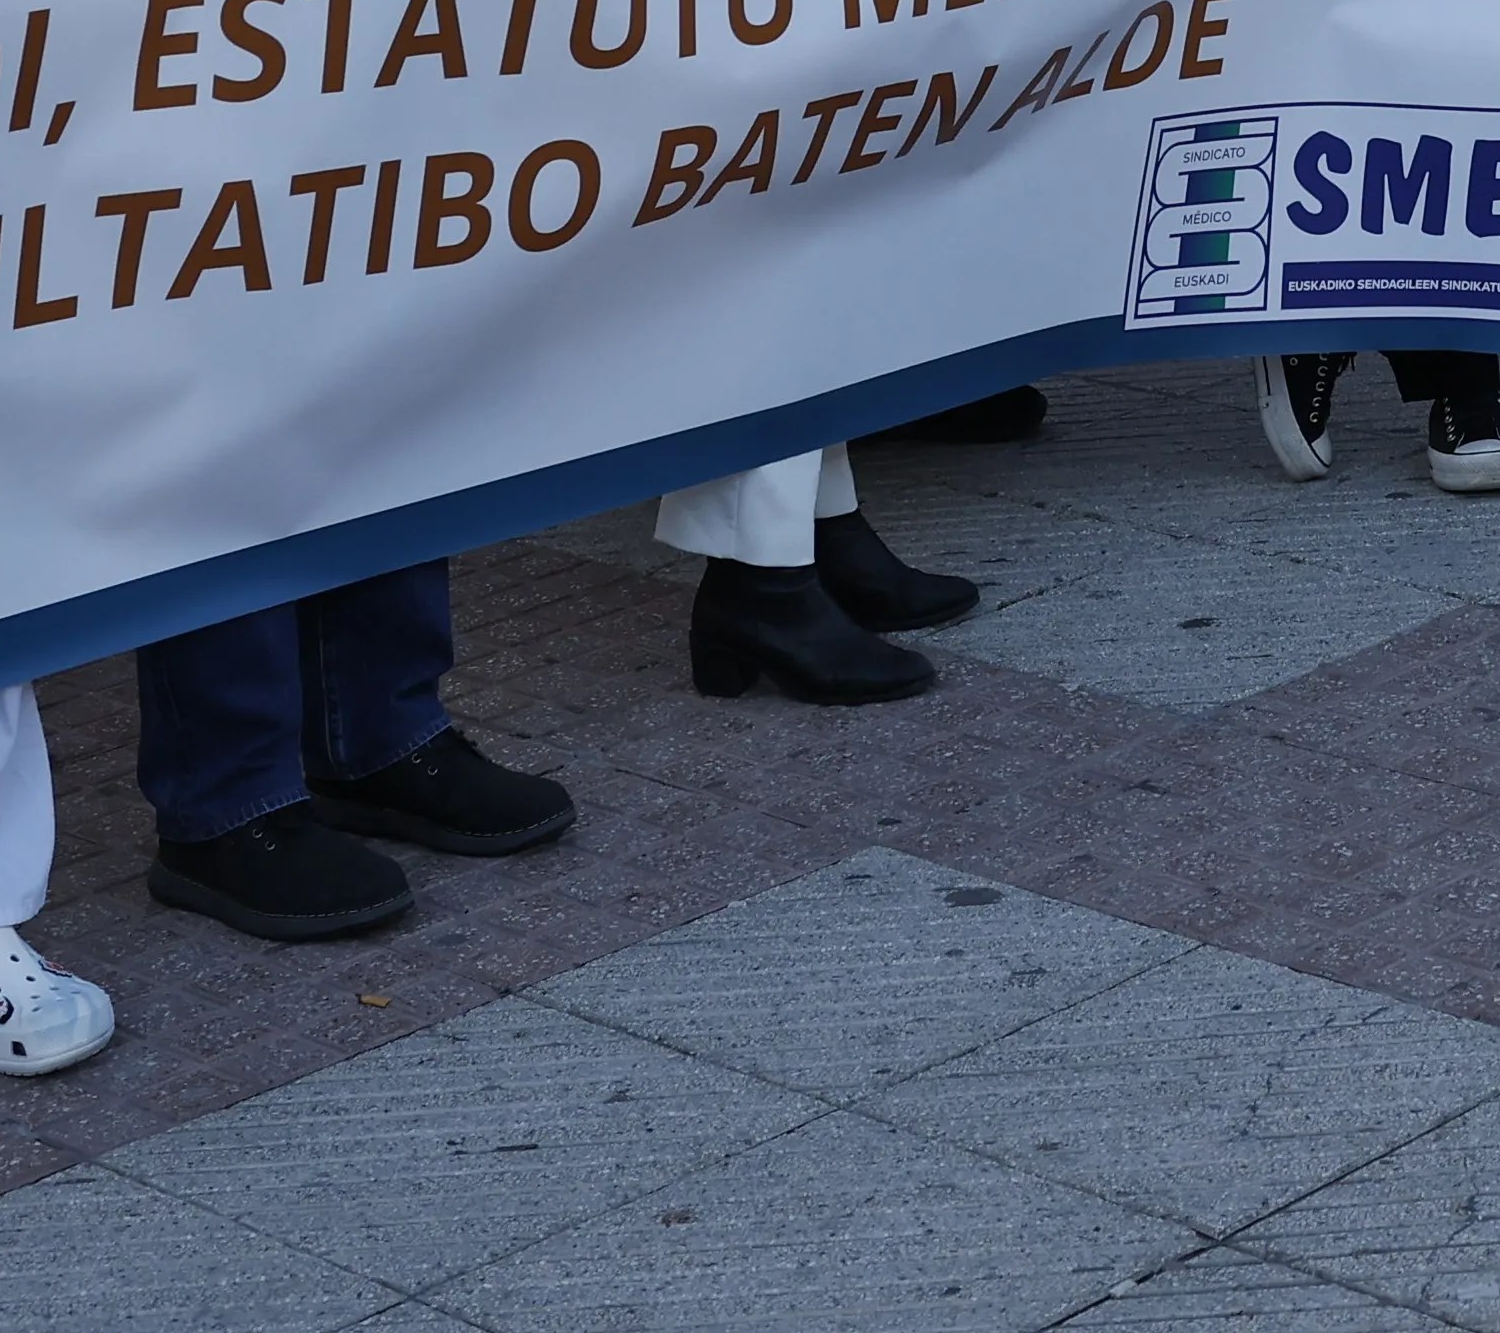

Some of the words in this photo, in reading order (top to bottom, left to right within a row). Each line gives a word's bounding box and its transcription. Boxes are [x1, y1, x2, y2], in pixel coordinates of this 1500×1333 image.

[632, 63, 1001, 228] BATEN
[1182, 146, 1246, 164] SINDICATO
[1182, 209, 1233, 226] MÉDICO
[1173, 273, 1230, 289] EUSKADI
[1287, 279, 1356, 293] EUSKADIKO
[1356, 278, 1440, 292] SENDAGILEEN
